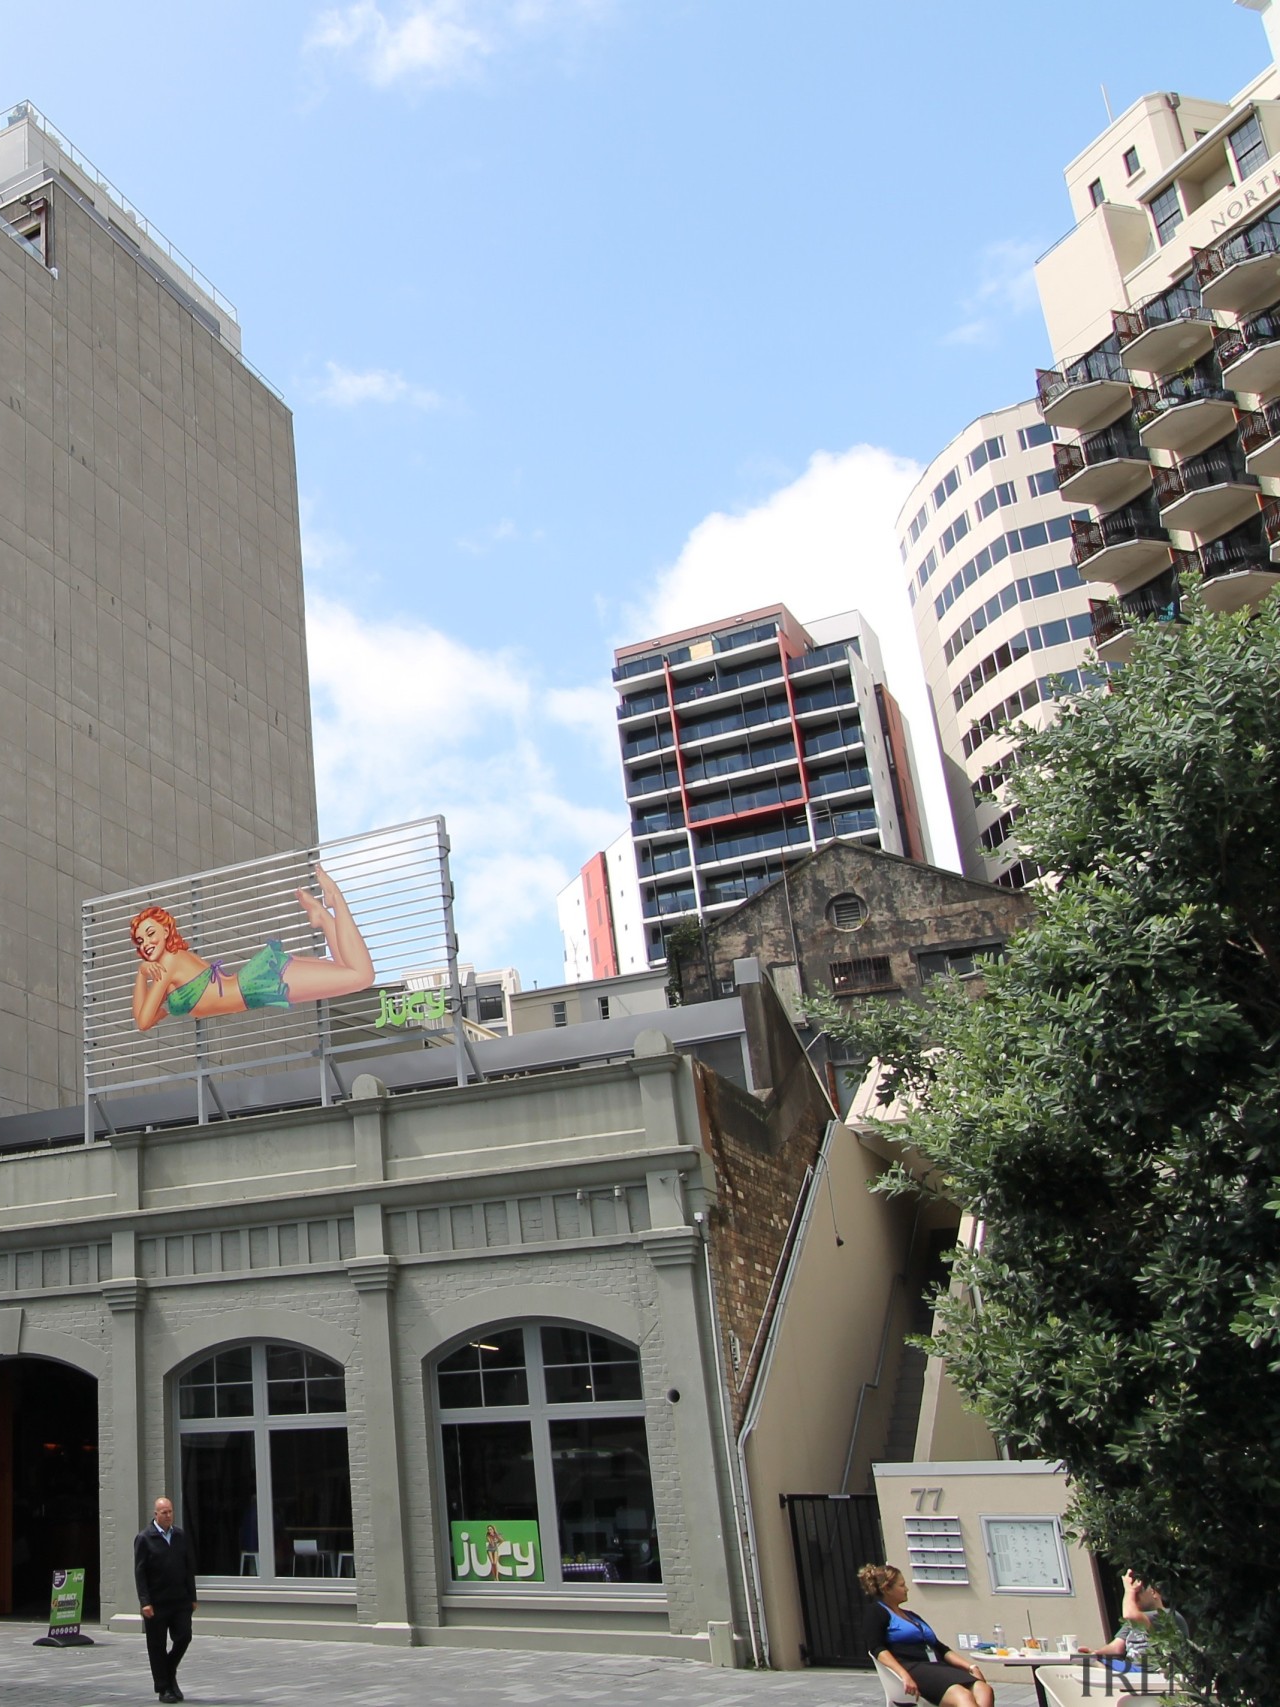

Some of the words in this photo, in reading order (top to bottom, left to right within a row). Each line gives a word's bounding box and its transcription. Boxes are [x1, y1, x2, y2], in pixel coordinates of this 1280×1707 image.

[375, 988, 445, 1029] jucy
[910, 1487, 943, 1511] 77
[457, 1531, 535, 1577] jucy
